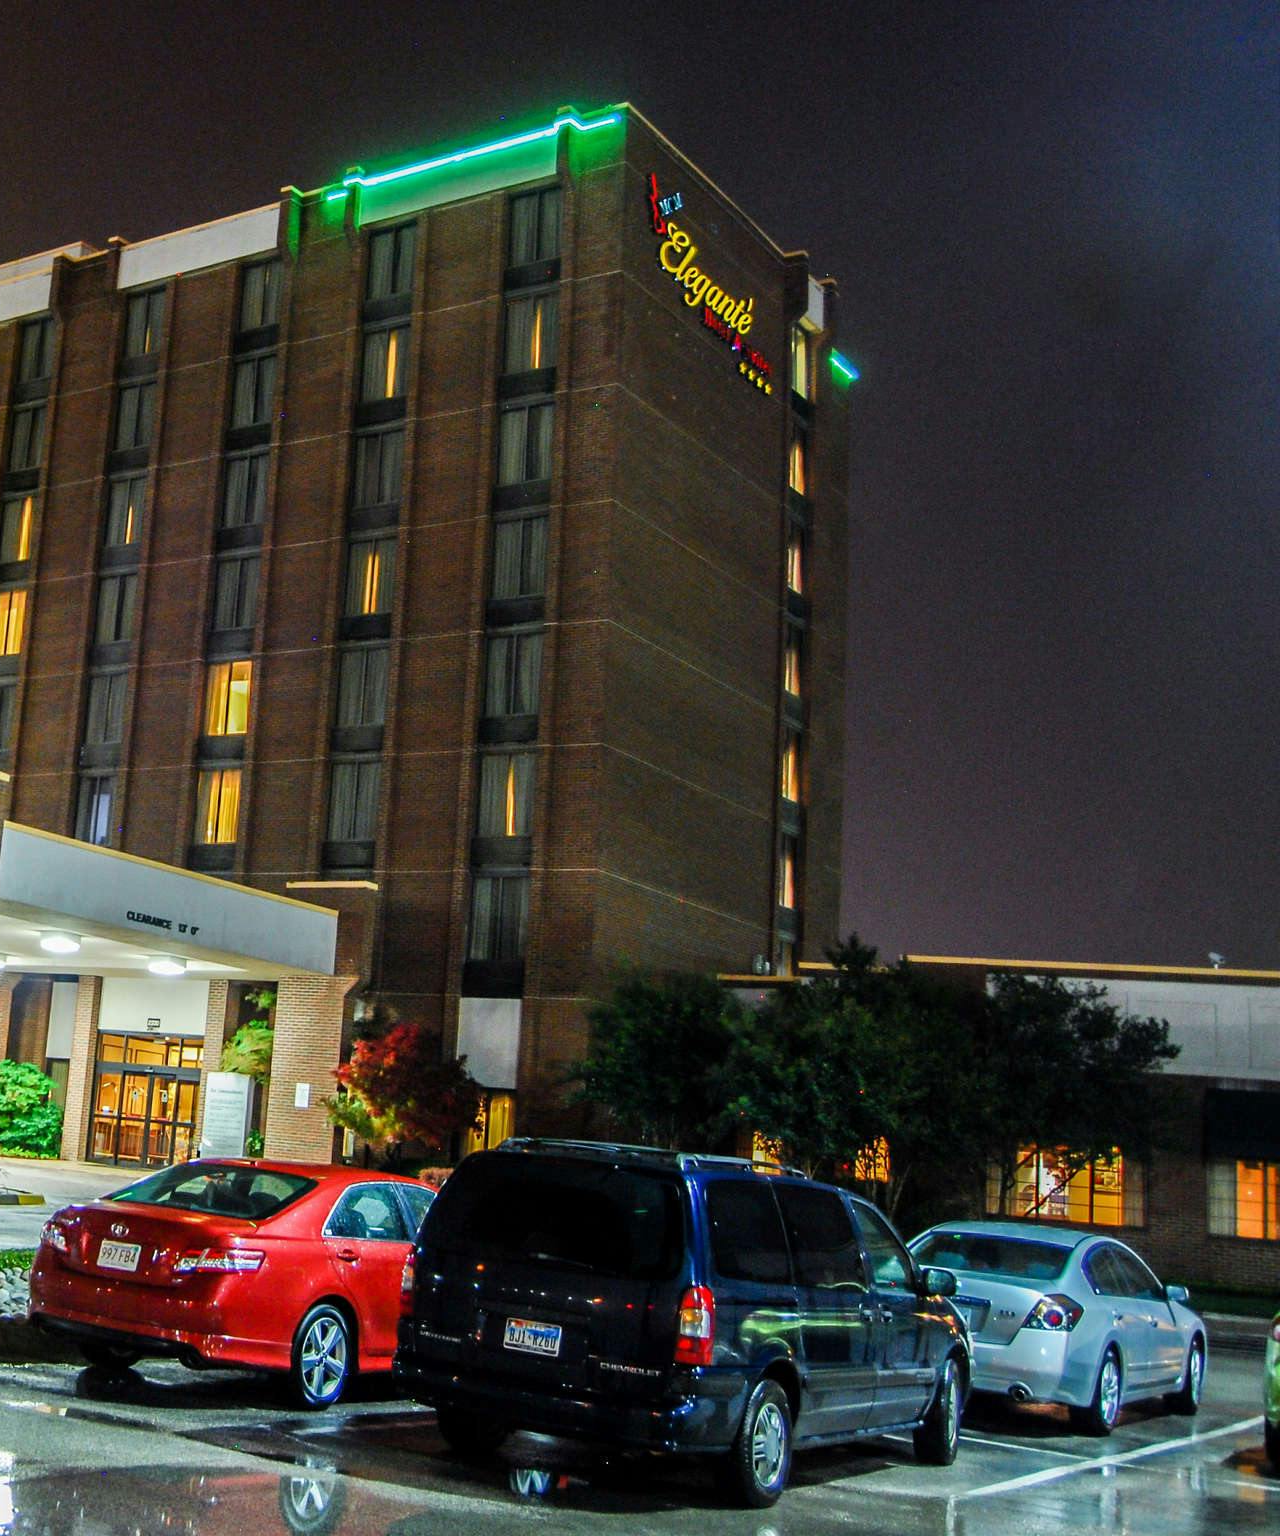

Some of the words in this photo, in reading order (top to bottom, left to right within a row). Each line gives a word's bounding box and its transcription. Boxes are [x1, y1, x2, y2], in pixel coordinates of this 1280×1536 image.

[126, 910, 172, 930] CLEARANCE
[101, 1246, 118, 1260] 997
[600, 1361, 661, 1377] CHEVROLET
